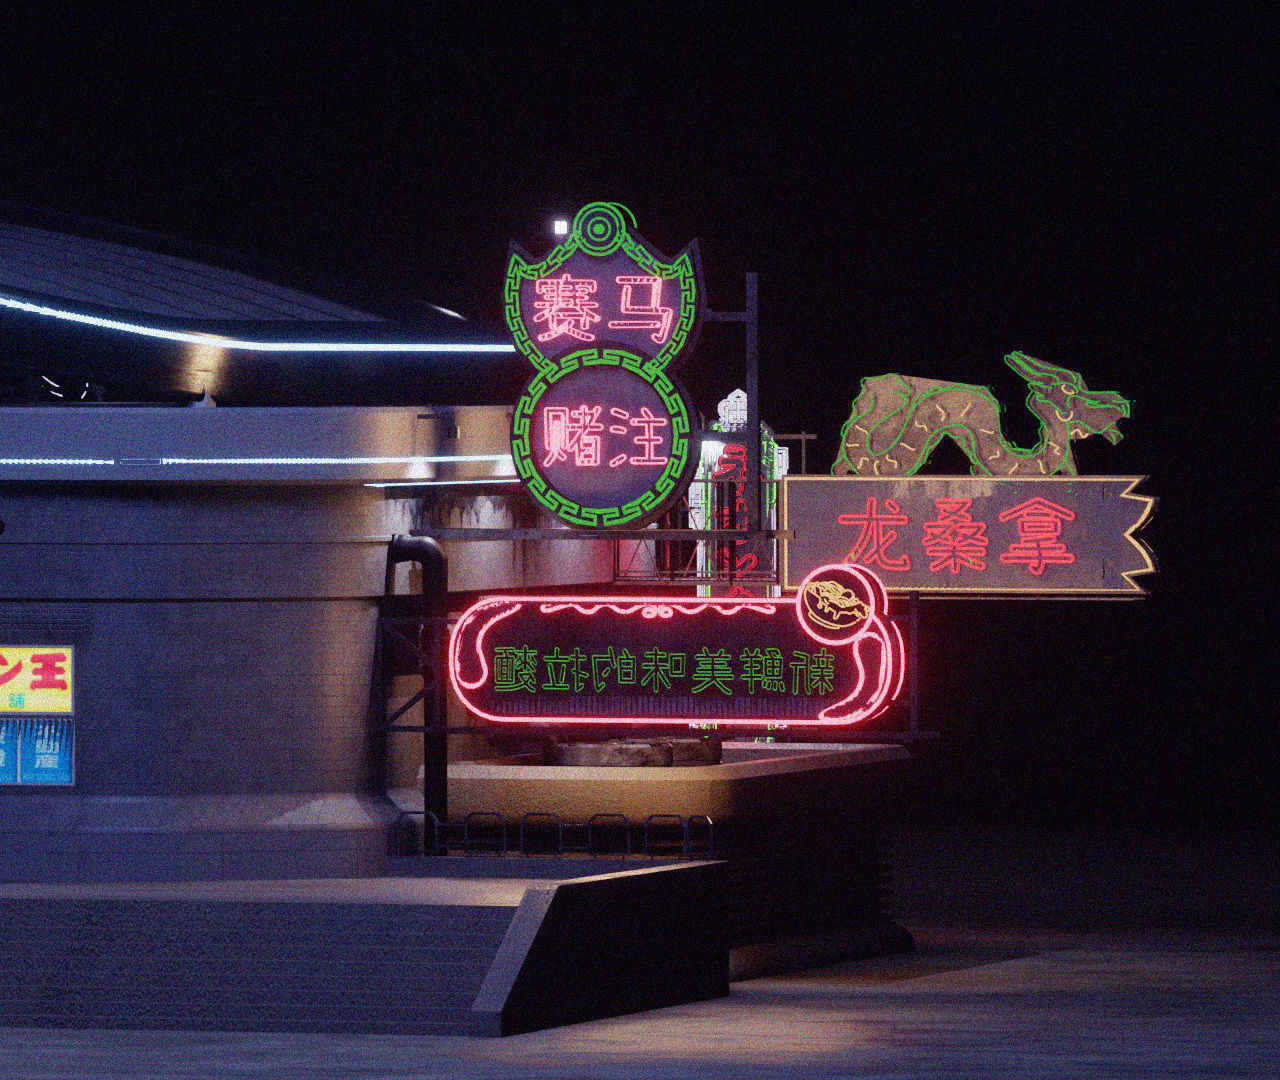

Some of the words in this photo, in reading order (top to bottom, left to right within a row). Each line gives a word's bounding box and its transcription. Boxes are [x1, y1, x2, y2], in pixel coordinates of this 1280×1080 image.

[533, 273, 674, 344] 赛马
[543, 404, 668, 467] 赌注
[837, 496, 1076, 576] 龙桑拿
